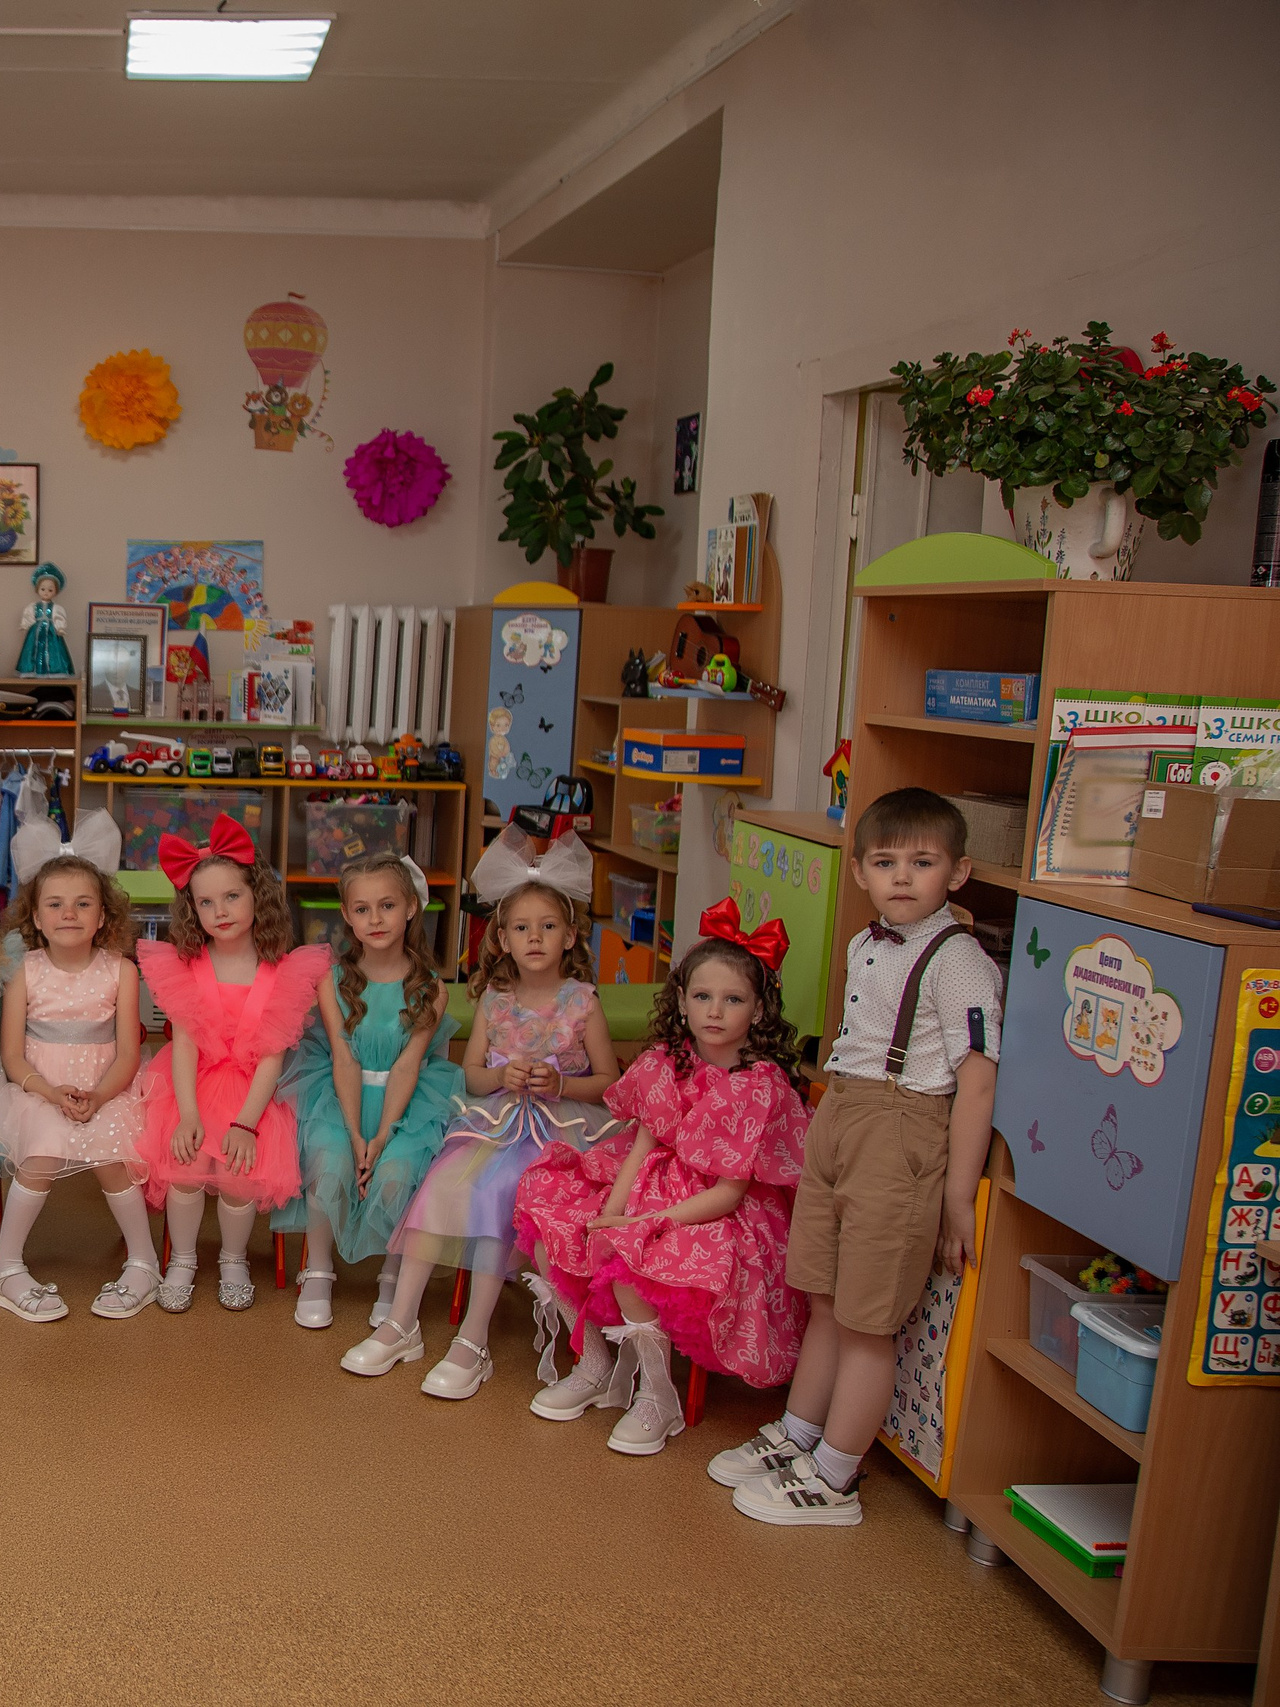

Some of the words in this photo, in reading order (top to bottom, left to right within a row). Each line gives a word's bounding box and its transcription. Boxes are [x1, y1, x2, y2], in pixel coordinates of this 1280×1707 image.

[955, 678, 990, 690] КОМПЛЕКТ
[926, 697, 936, 707] 48
[949, 695, 997, 708] МАТЕМАТИКА
[1228, 732, 1265, 744] СЕМИ
[1098, 951, 1123, 972] Центр
[1072, 965, 1131, 995] дидактических
[1132, 986, 1146, 999] игр
[1228, 1207, 1253, 1227] Ж
[1222, 1250, 1243, 1271] Н
[944, 1288, 953, 1305] И
[1219, 1293, 1236, 1314] У
[921, 1307, 932, 1324] М
[941, 1320, 950, 1336] Н
[917, 1338, 925, 1352] С
[1213, 1336, 1239, 1358] Щ
[914, 1368, 922, 1387] Ц
[934, 1382, 941, 1398] Ч
[911, 1398, 921, 1415] Ы
[890, 1413, 900, 1430] Ю
[907, 1428, 915, 1444] Я
